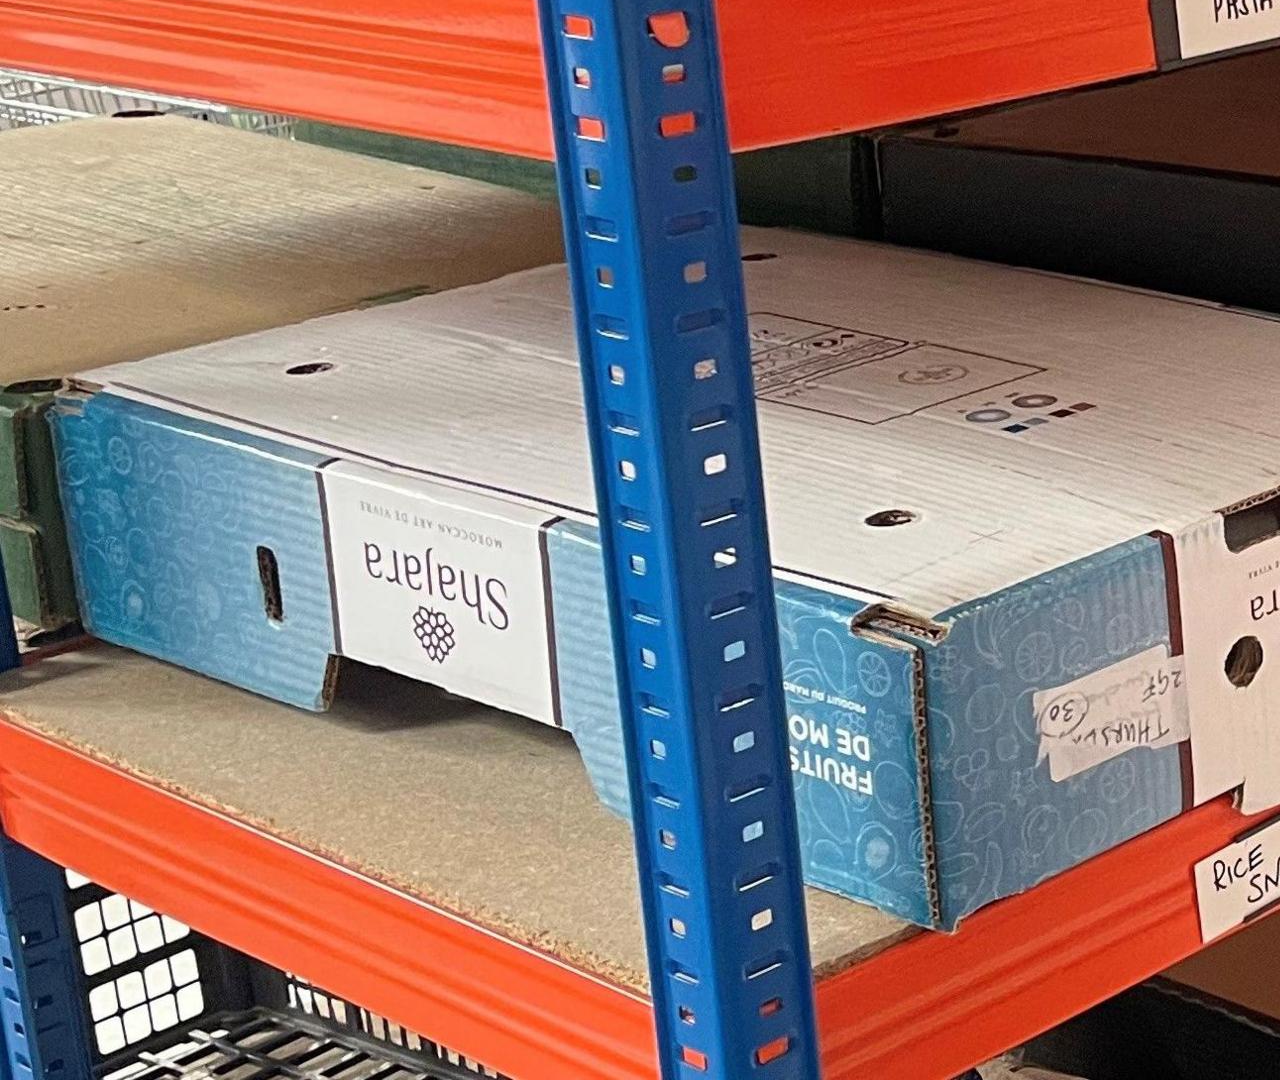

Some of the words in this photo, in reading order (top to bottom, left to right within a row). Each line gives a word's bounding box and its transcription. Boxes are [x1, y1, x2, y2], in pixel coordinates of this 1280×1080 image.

[359, 501, 391, 519] VIVRE
[395, 510, 408, 524] DE
[413, 515, 433, 530] ART
[438, 523, 503, 549] MOROCCAN
[364, 542, 508, 630] Shajara
[811, 690, 825, 702] DU
[826, 693, 867, 714] PRODUIT
[1049, 699, 1074, 722] 30
[788, 715, 829, 748] MO
[836, 728, 870, 761] DE
[789, 746, 872, 795] FRUITS
[1213, 843, 1264, 891] RICE
